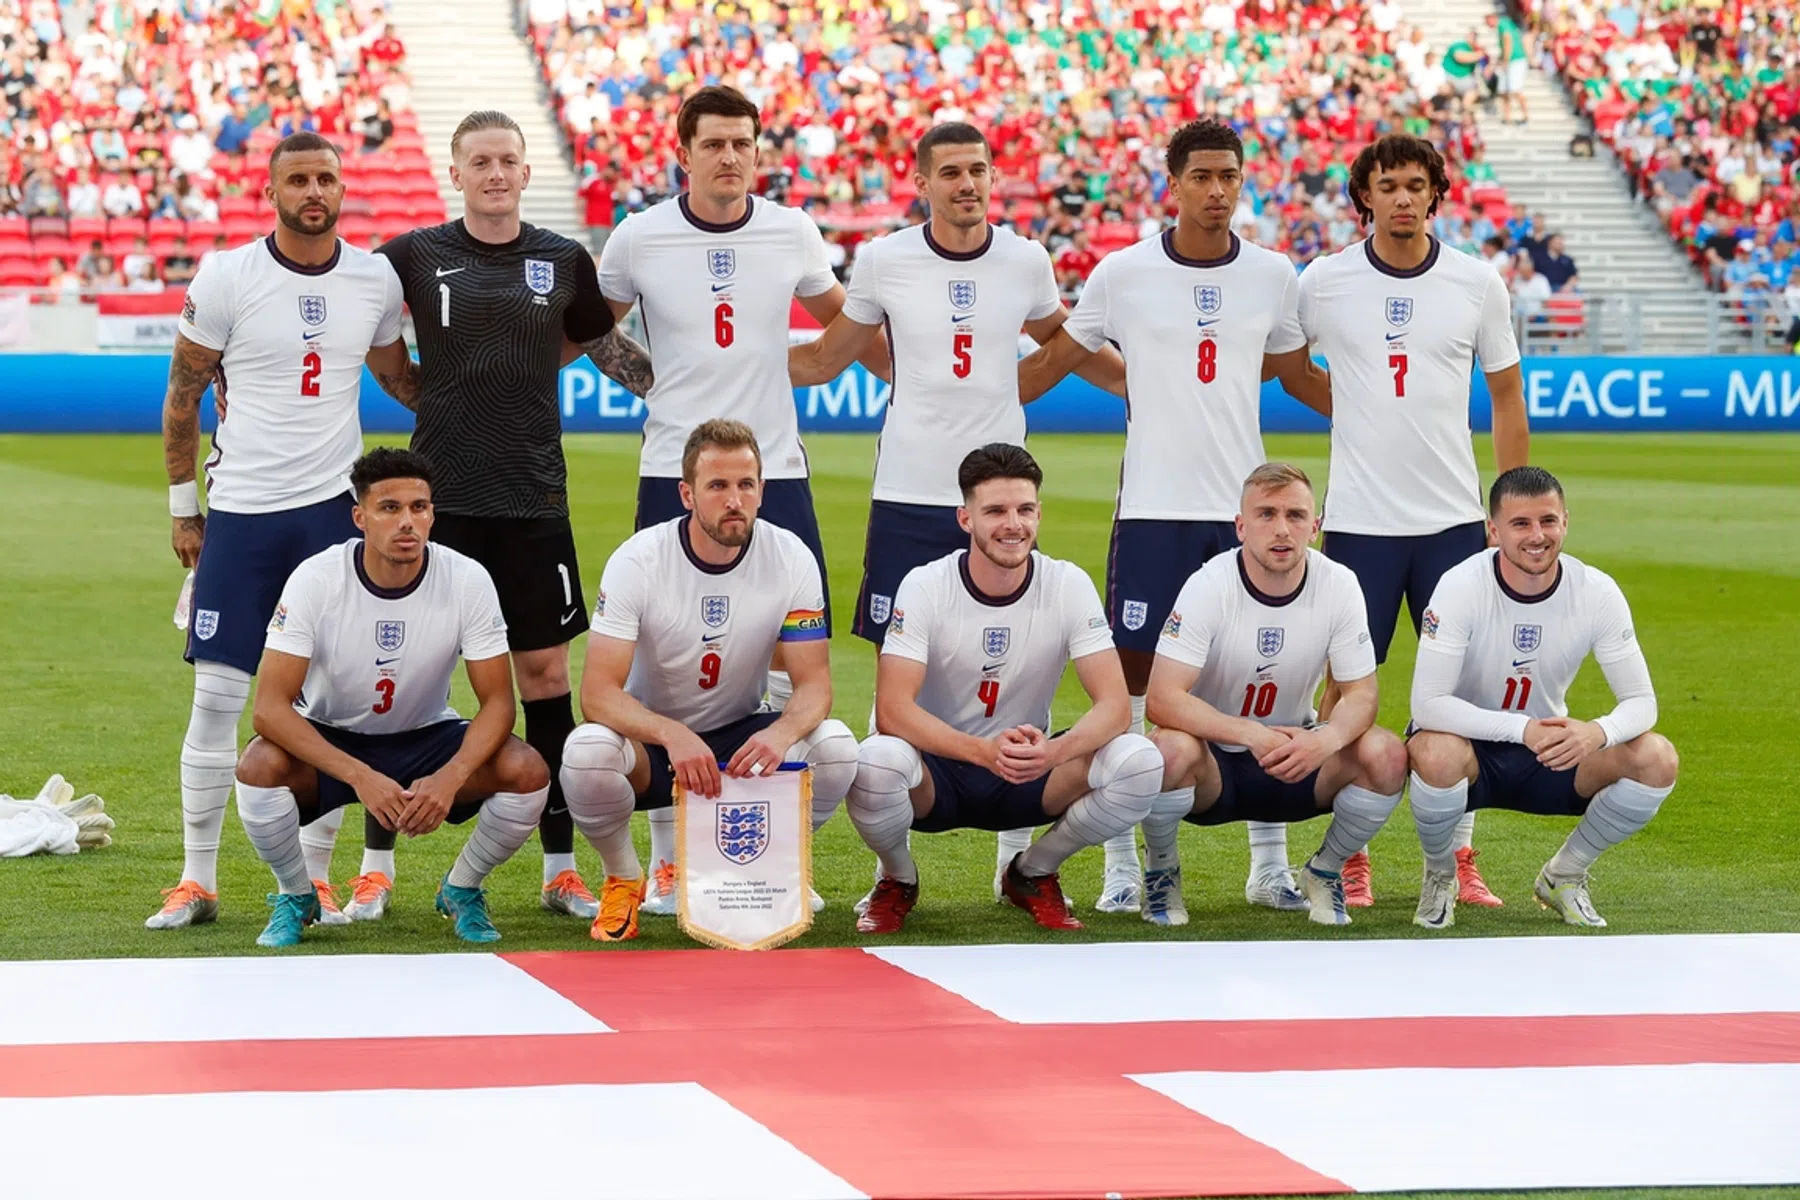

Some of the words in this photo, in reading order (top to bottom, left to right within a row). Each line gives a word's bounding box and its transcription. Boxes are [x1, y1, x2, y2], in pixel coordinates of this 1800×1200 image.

[438, 283, 450, 327] 1
[714, 302, 734, 349] 6
[301, 351, 322, 397] 2
[952, 334, 973, 379] 5
[1197, 338, 1217, 384] 8
[1388, 354, 1408, 397] 7
[1522, 369, 1667, 417] EACE
[557, 562, 572, 606] 1
[698, 651, 721, 690] 9
[372, 678, 396, 715] 3
[977, 680, 1000, 719] 4
[1240, 681, 1278, 718] 10
[1501, 676, 1532, 711] 11
